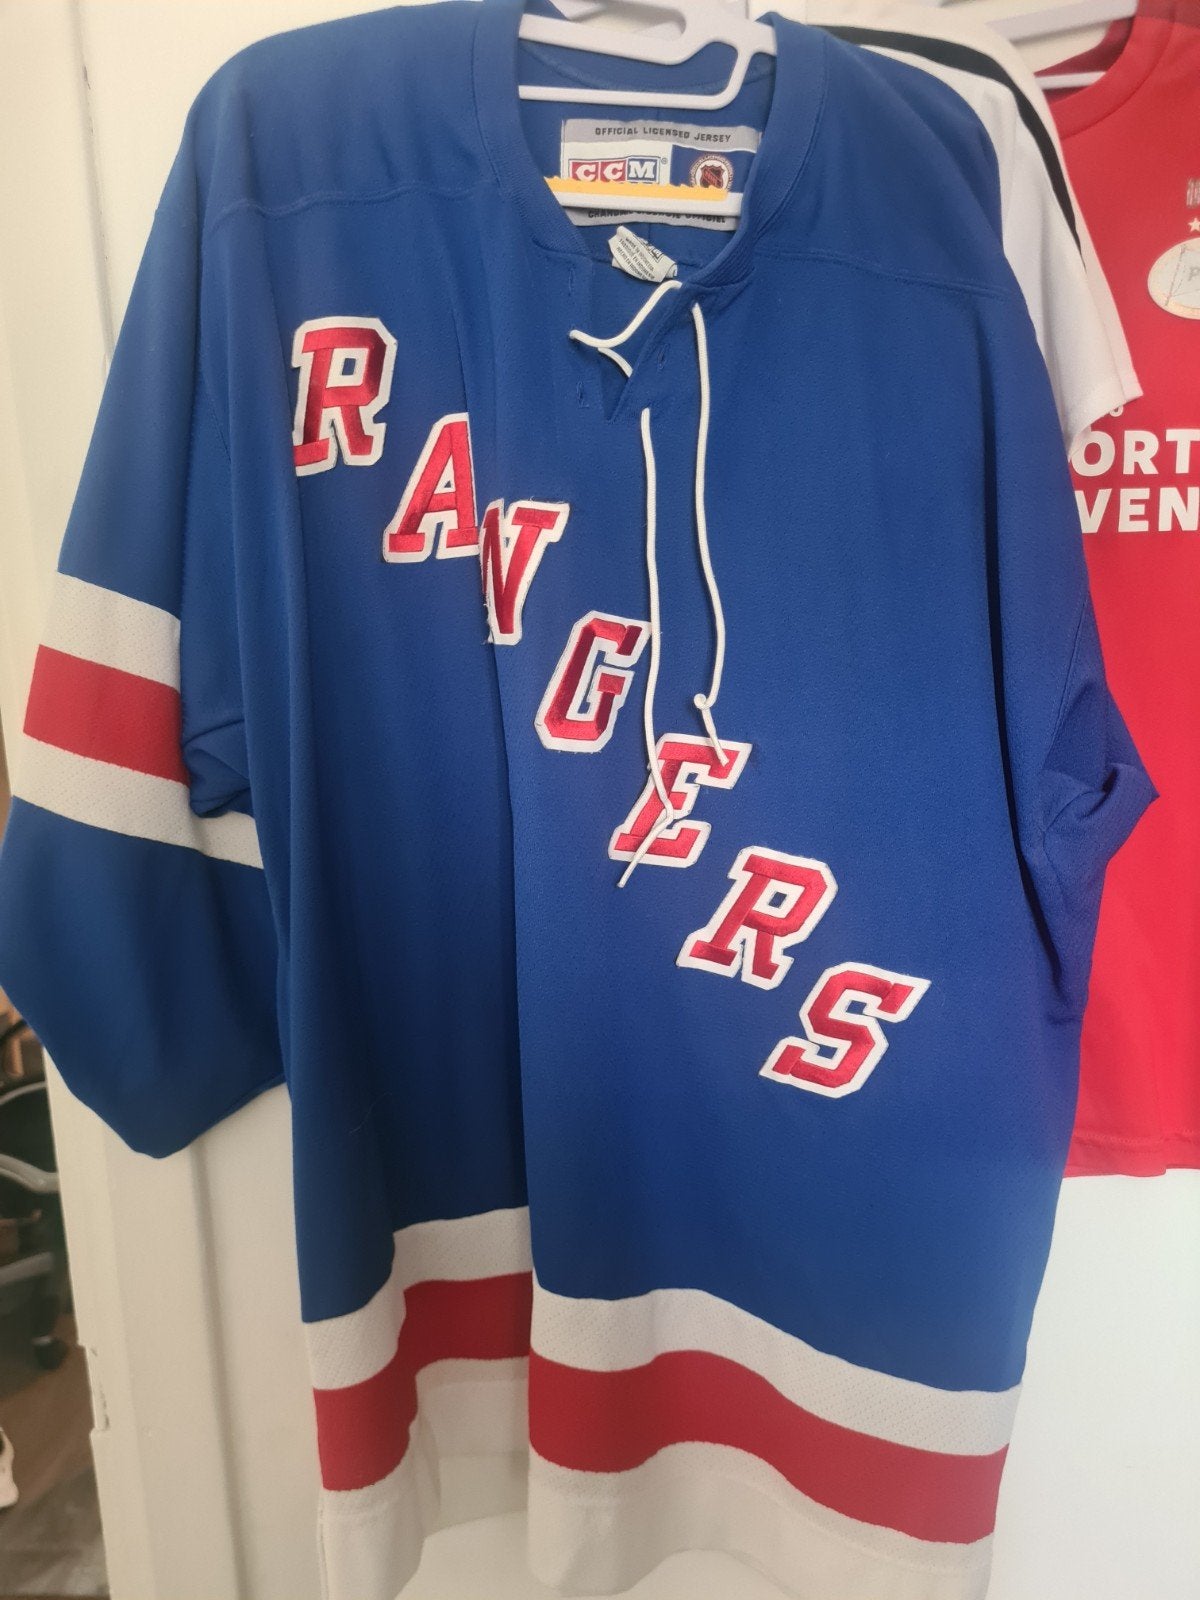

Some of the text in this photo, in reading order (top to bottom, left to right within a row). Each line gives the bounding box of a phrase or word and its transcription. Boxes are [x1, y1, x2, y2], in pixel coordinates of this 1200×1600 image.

[595, 126, 731, 143] OFFICIAL LICENSED JERSEY
[573, 160, 657, 183] CCM
[291, 316, 931, 1098] RANGERS
